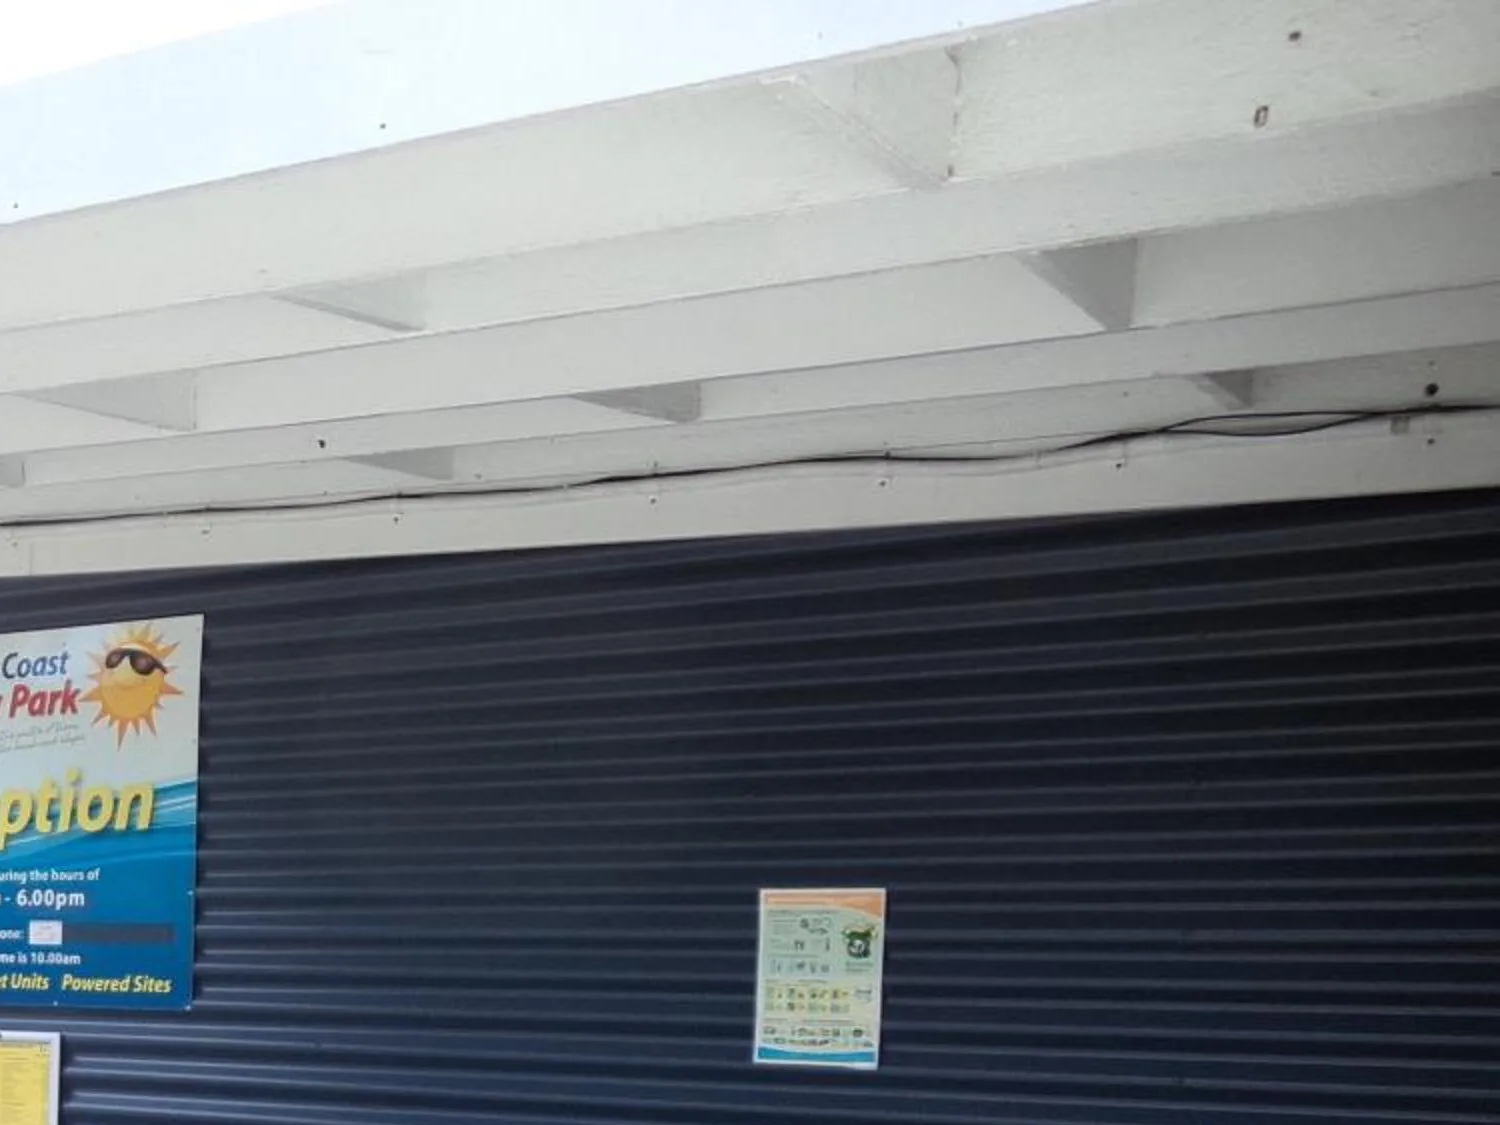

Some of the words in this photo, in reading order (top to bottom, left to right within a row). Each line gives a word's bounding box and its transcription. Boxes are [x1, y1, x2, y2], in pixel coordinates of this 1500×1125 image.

[2, 651, 70, 680] Coast
[9, 680, 81, 719] Park
[30, 869, 48, 881] the
[51, 868, 85, 881] hours
[87, 868, 101, 881] of
[16, 888, 85, 910] 6.00pm
[18, 951, 27, 964] is
[30, 952, 81, 965] 10.00am
[11, 972, 50, 990] Units
[61, 973, 131, 992] Powered
[133, 975, 173, 993] Sites
